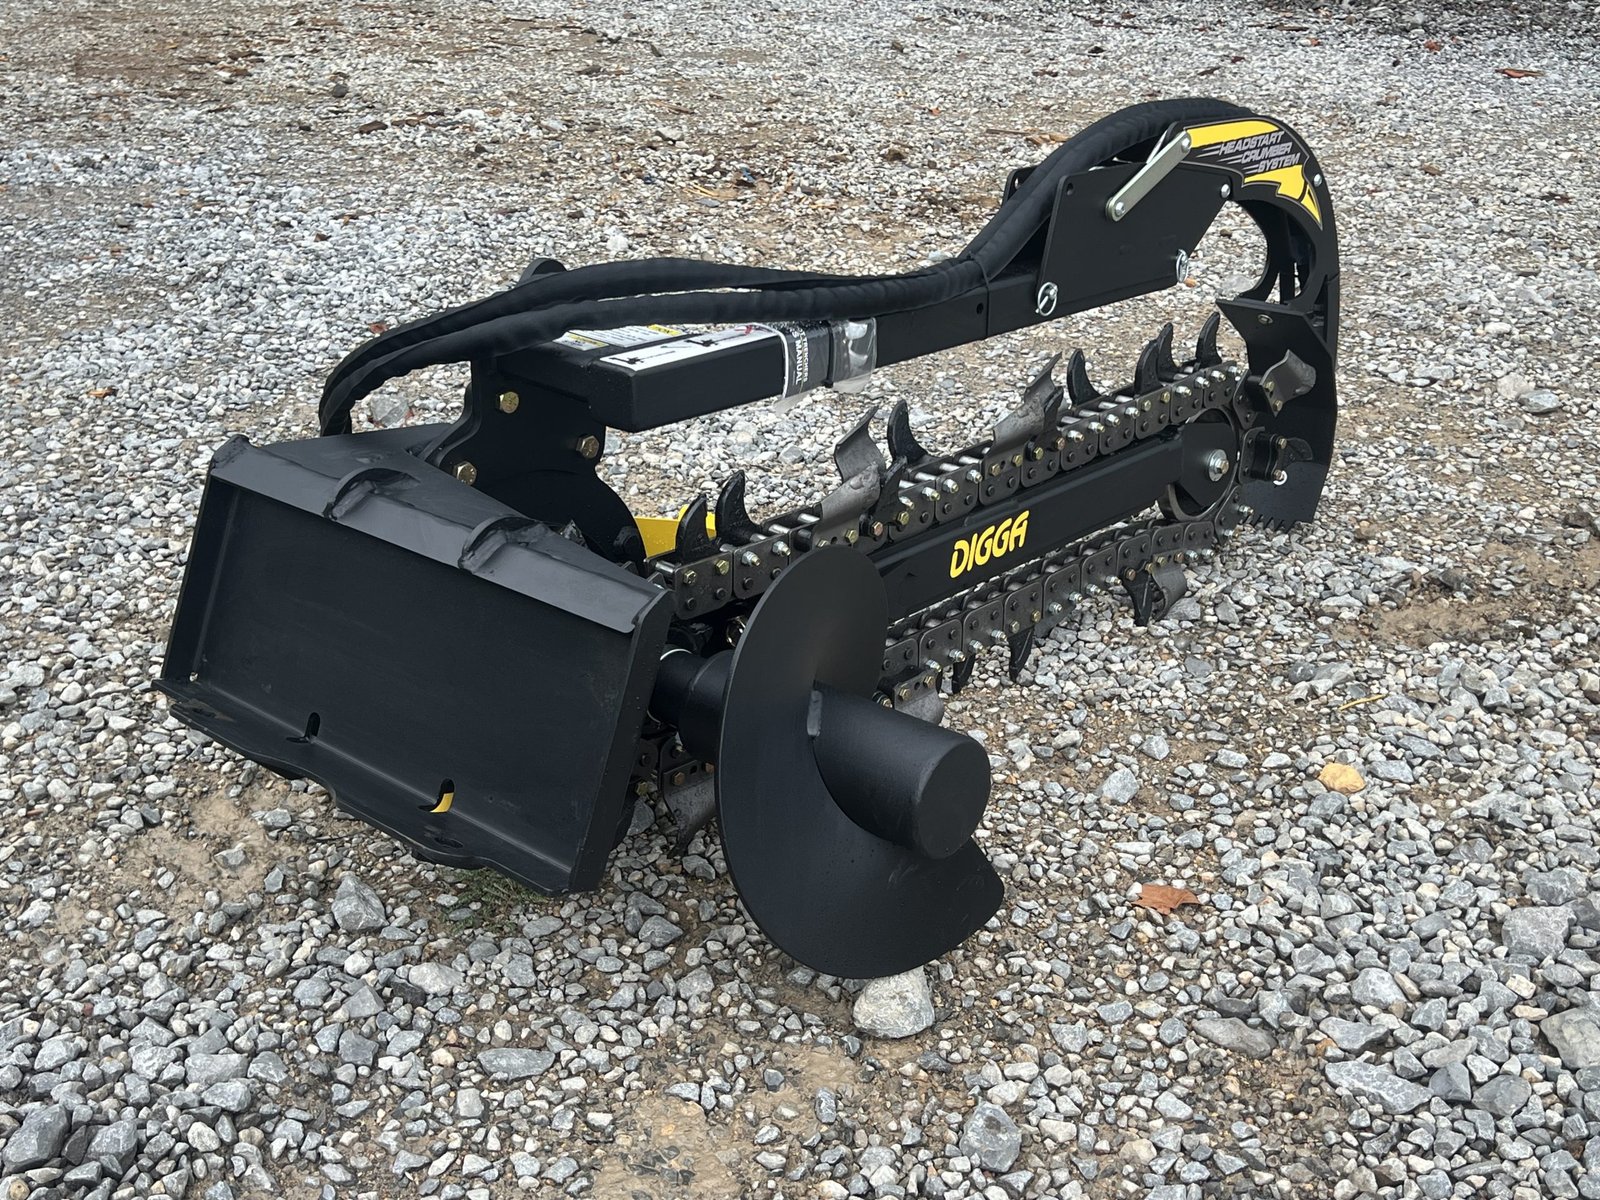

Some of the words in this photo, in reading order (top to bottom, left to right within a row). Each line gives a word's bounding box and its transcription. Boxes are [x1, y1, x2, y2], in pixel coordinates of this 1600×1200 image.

[1218, 131, 1285, 155] HEADSTART
[1240, 142, 1293, 164] CRUMBER
[1257, 153, 1301, 173] SYSTEM
[795, 339, 803, 385] MANUAL
[949, 510, 1030, 579] DIGGA
